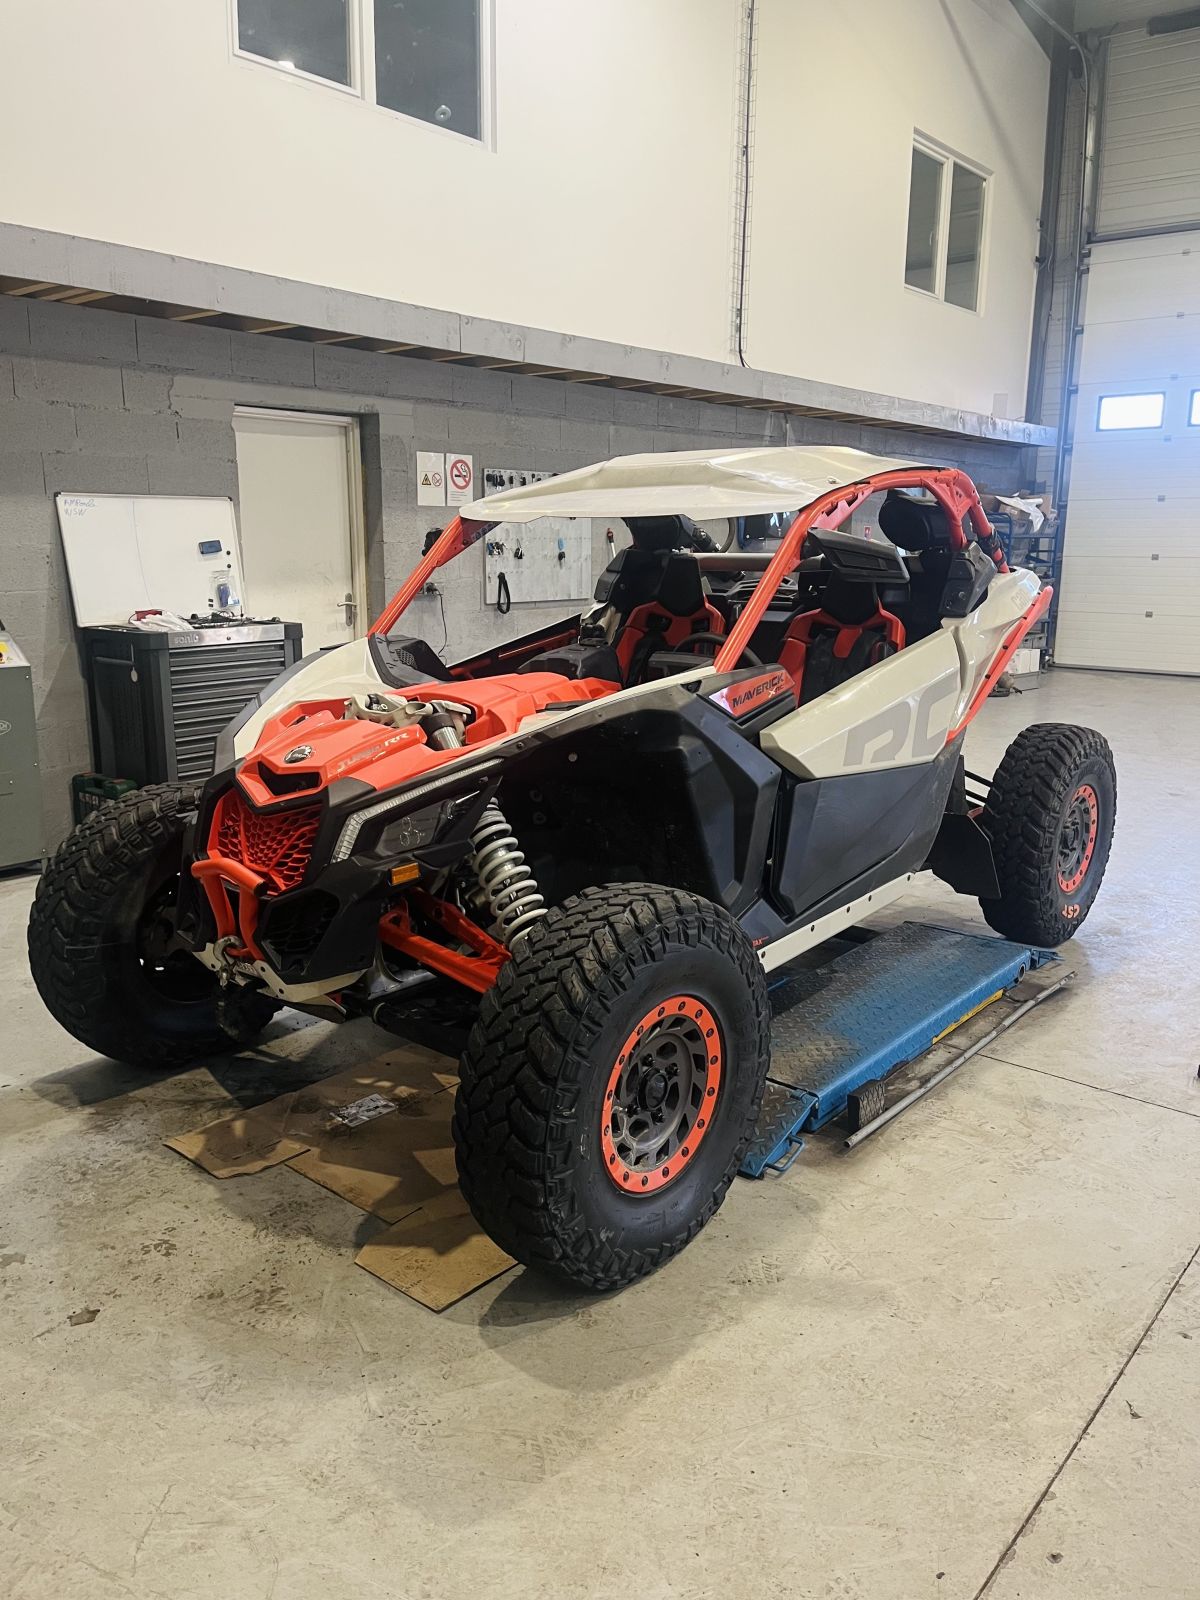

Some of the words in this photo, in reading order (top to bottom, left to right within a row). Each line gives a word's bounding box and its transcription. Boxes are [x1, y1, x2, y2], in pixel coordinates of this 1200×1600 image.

[732, 673, 784, 708] MAVERICK
[843, 669, 959, 767] RC
[1061, 904, 1080, 919] CST
